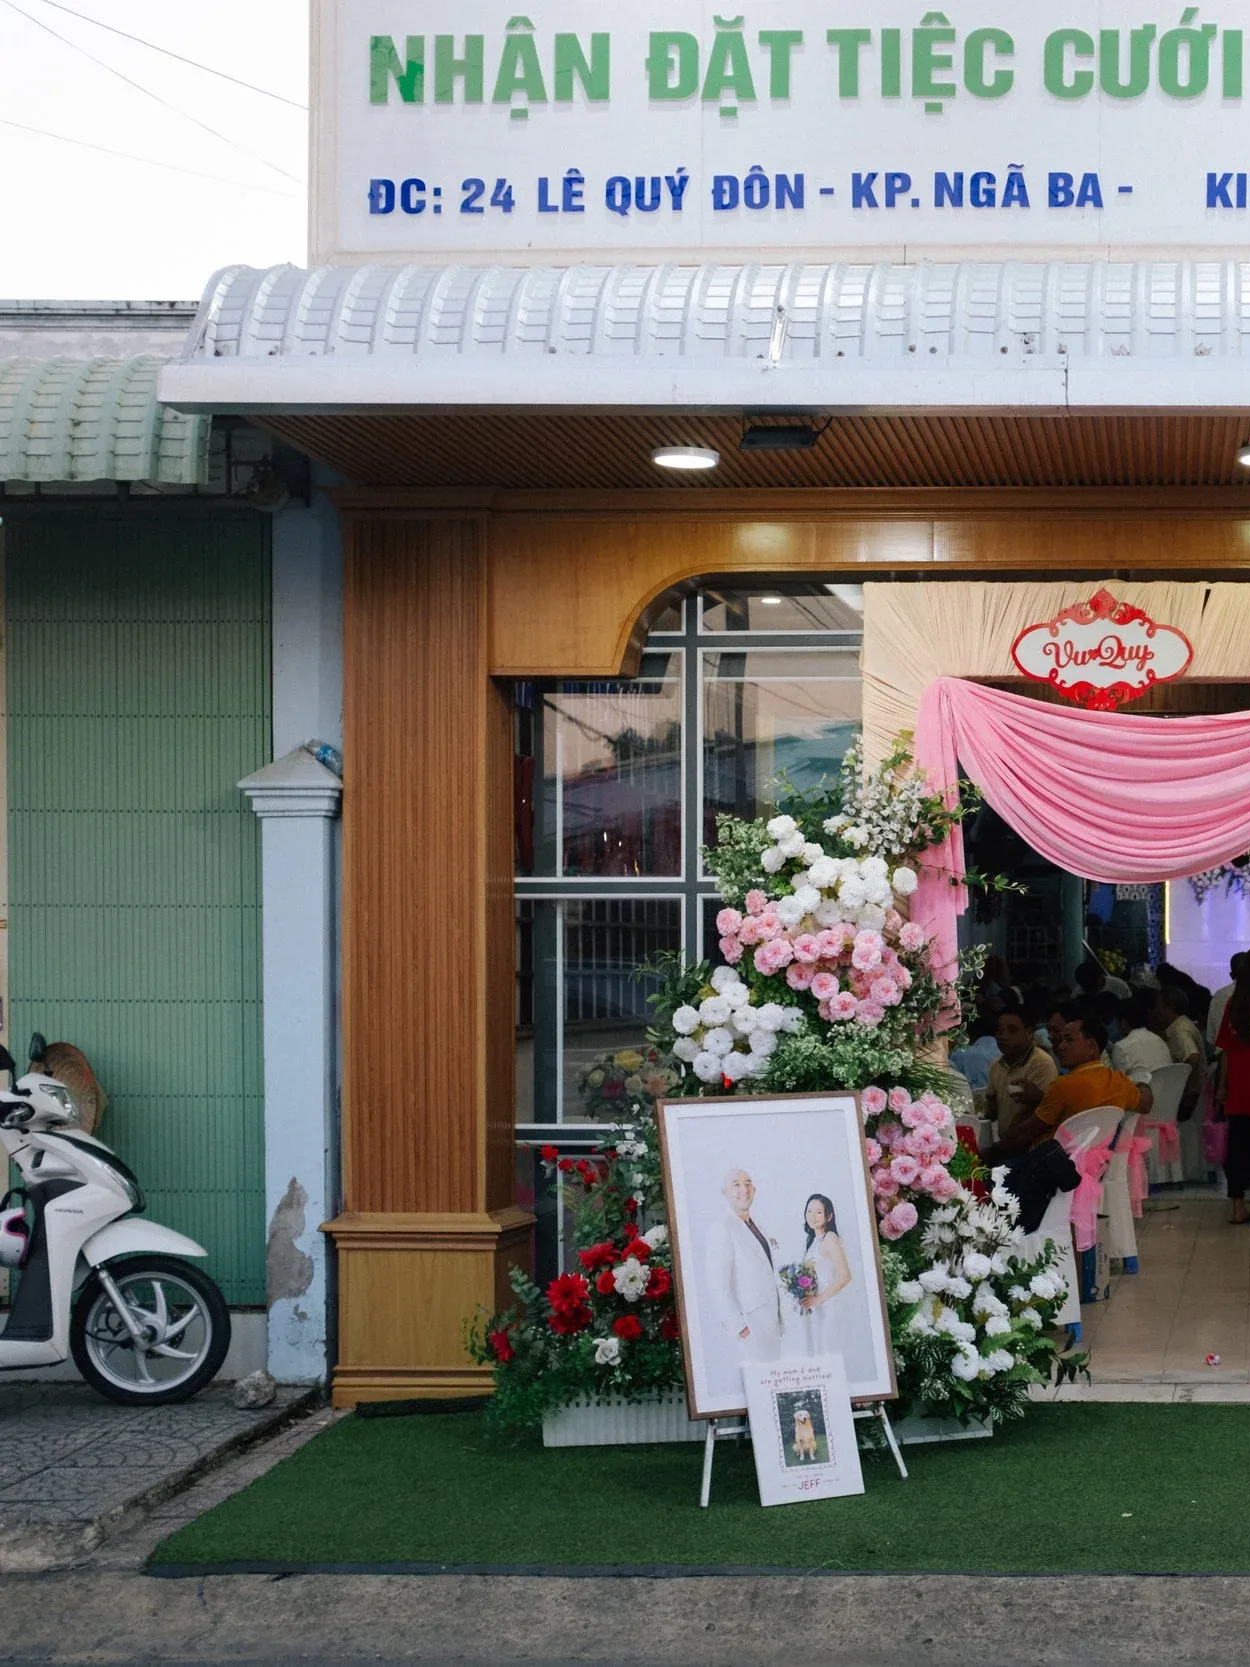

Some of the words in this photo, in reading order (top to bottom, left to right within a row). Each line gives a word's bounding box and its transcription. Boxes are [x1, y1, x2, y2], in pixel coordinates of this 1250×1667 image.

[369, 16, 610, 120] NHẬN
[645, 15, 803, 117] ĐẶT
[829, 12, 1014, 113] TIỆC
[1044, 7, 1243, 100] CƯỚI
[367, 178, 443, 216] ĐC:
[460, 177, 516, 214] 24
[538, 168, 586, 214] LÊ
[605, 167, 690, 216] QUÝ
[711, 165, 805, 212] ĐÔN
[1047, 171, 1104, 209] BA
[1097, 634, 1155, 672] Quy
[774, 1376, 801, 1387] getting
[798, 1478, 821, 1490] JEFF
